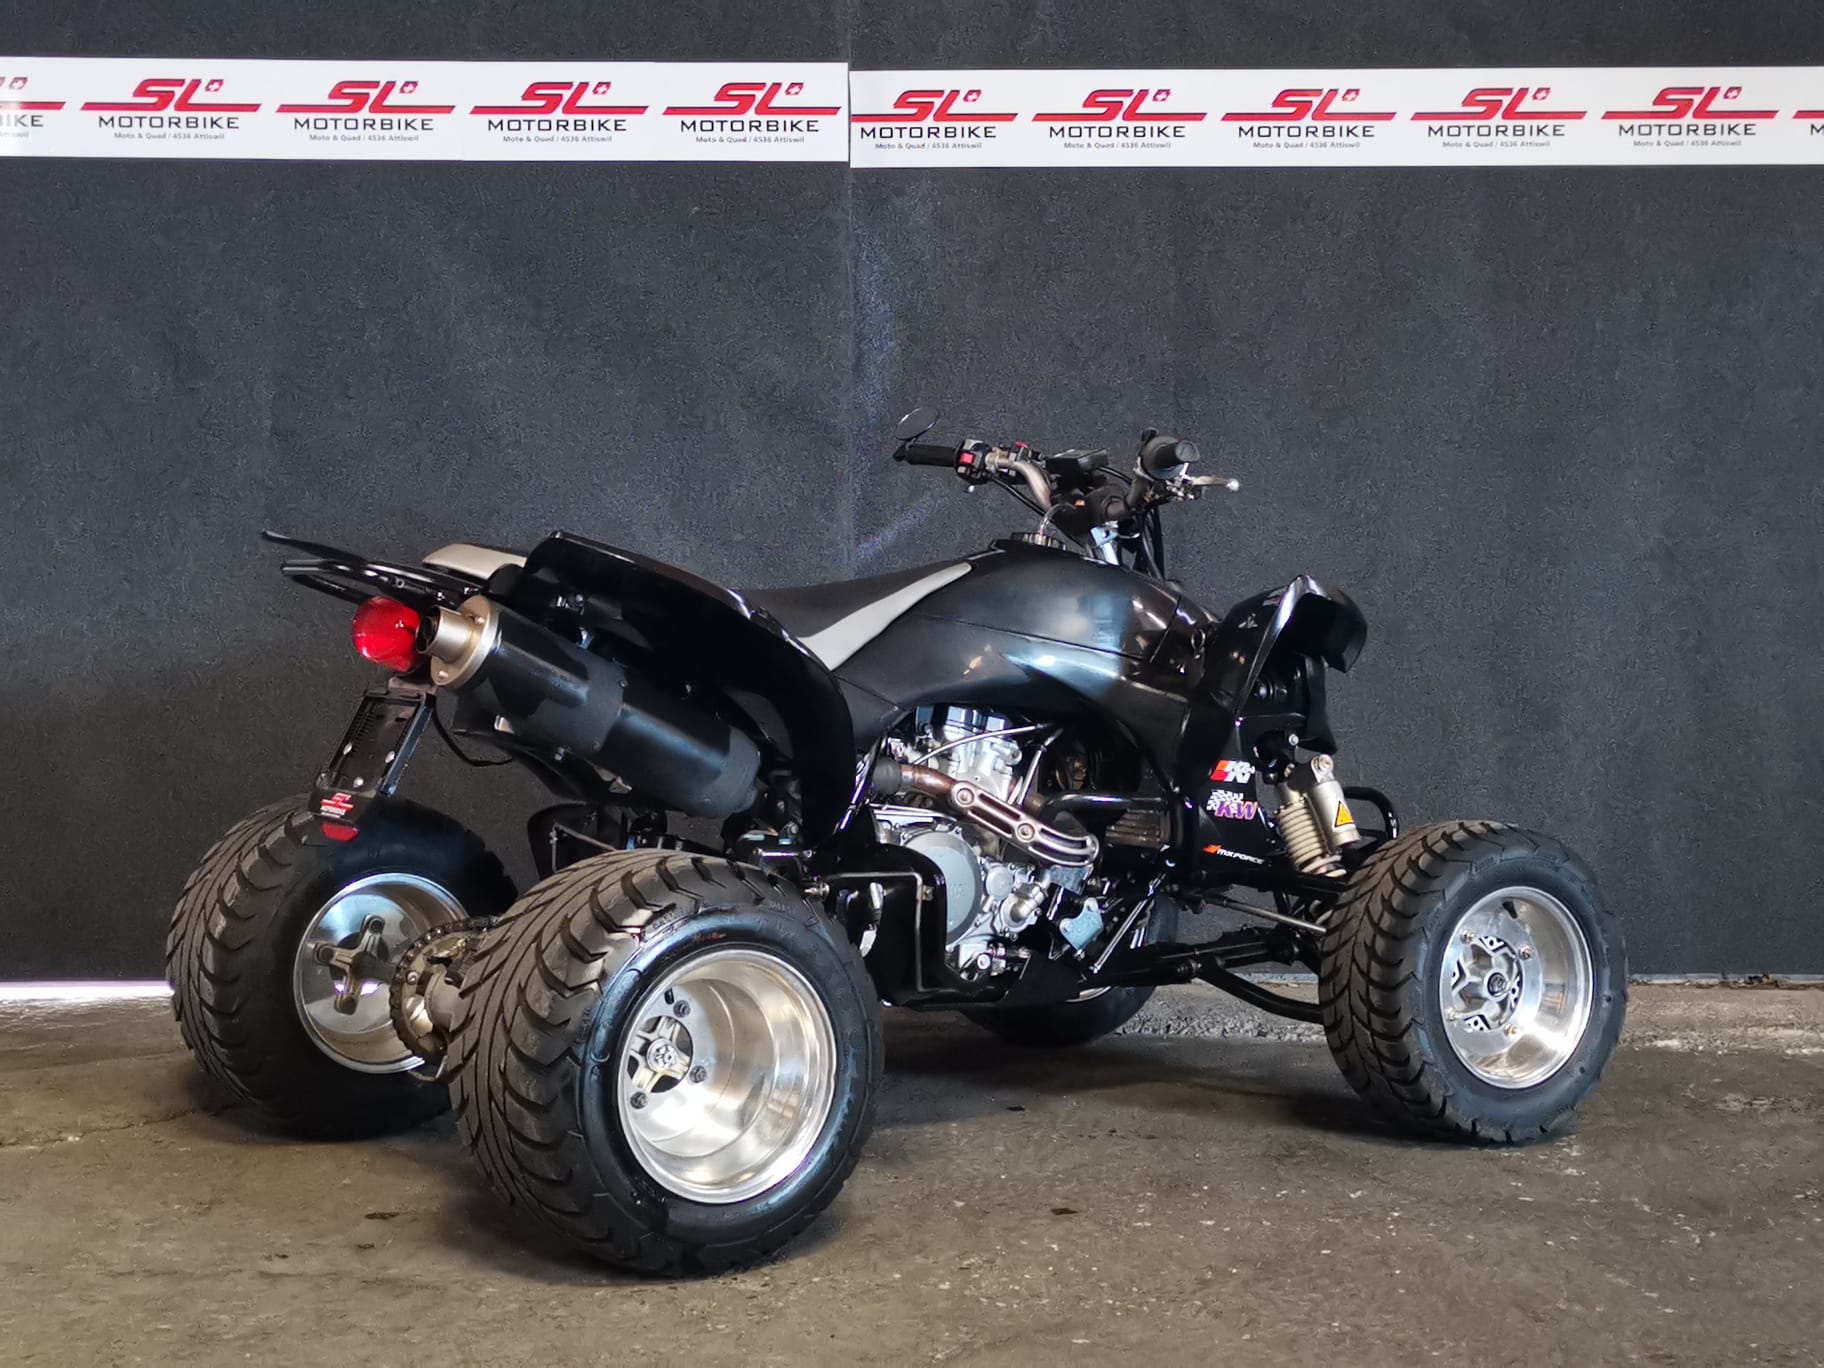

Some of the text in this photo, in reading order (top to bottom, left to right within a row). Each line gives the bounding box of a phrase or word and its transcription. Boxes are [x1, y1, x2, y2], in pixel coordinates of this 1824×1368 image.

[98, 116, 239, 130] MOTORBIKE
[294, 118, 434, 132] MOTORBIKE
[488, 119, 628, 133] MOTORBIKE
[680, 119, 820, 134] MOTORBIKE
[114, 132, 135, 140] Moto
[146, 132, 166, 141] Quad
[860, 126, 998, 140] MOTORBIKE
[1049, 126, 1186, 139] MOTORBIKE
[1238, 125, 1375, 139] MOTORBIKE
[1428, 125, 1566, 138] MOTORBIKE
[1619, 124, 1757, 138] MOTORBIKE
[309, 134, 330, 142] Moto
[341, 134, 361, 143] Quad
[503, 135, 524, 143] Moto
[534, 135, 554, 144] Quad
[696, 135, 716, 144] Moto
[727, 135, 747, 145] Quad
[1633, 139, 1653, 147] Moto
[1664, 139, 1684, 148] Quad
[875, 142, 895, 150] Moto
[905, 142, 925, 151] Quad
[1064, 141, 1084, 149] Moto
[1094, 141, 1114, 150] Quad
[1253, 141, 1273, 149] Moto
[1284, 141, 1303, 150] Quad
[1443, 140, 1463, 148] Moto
[1473, 140, 1493, 149] Quad
